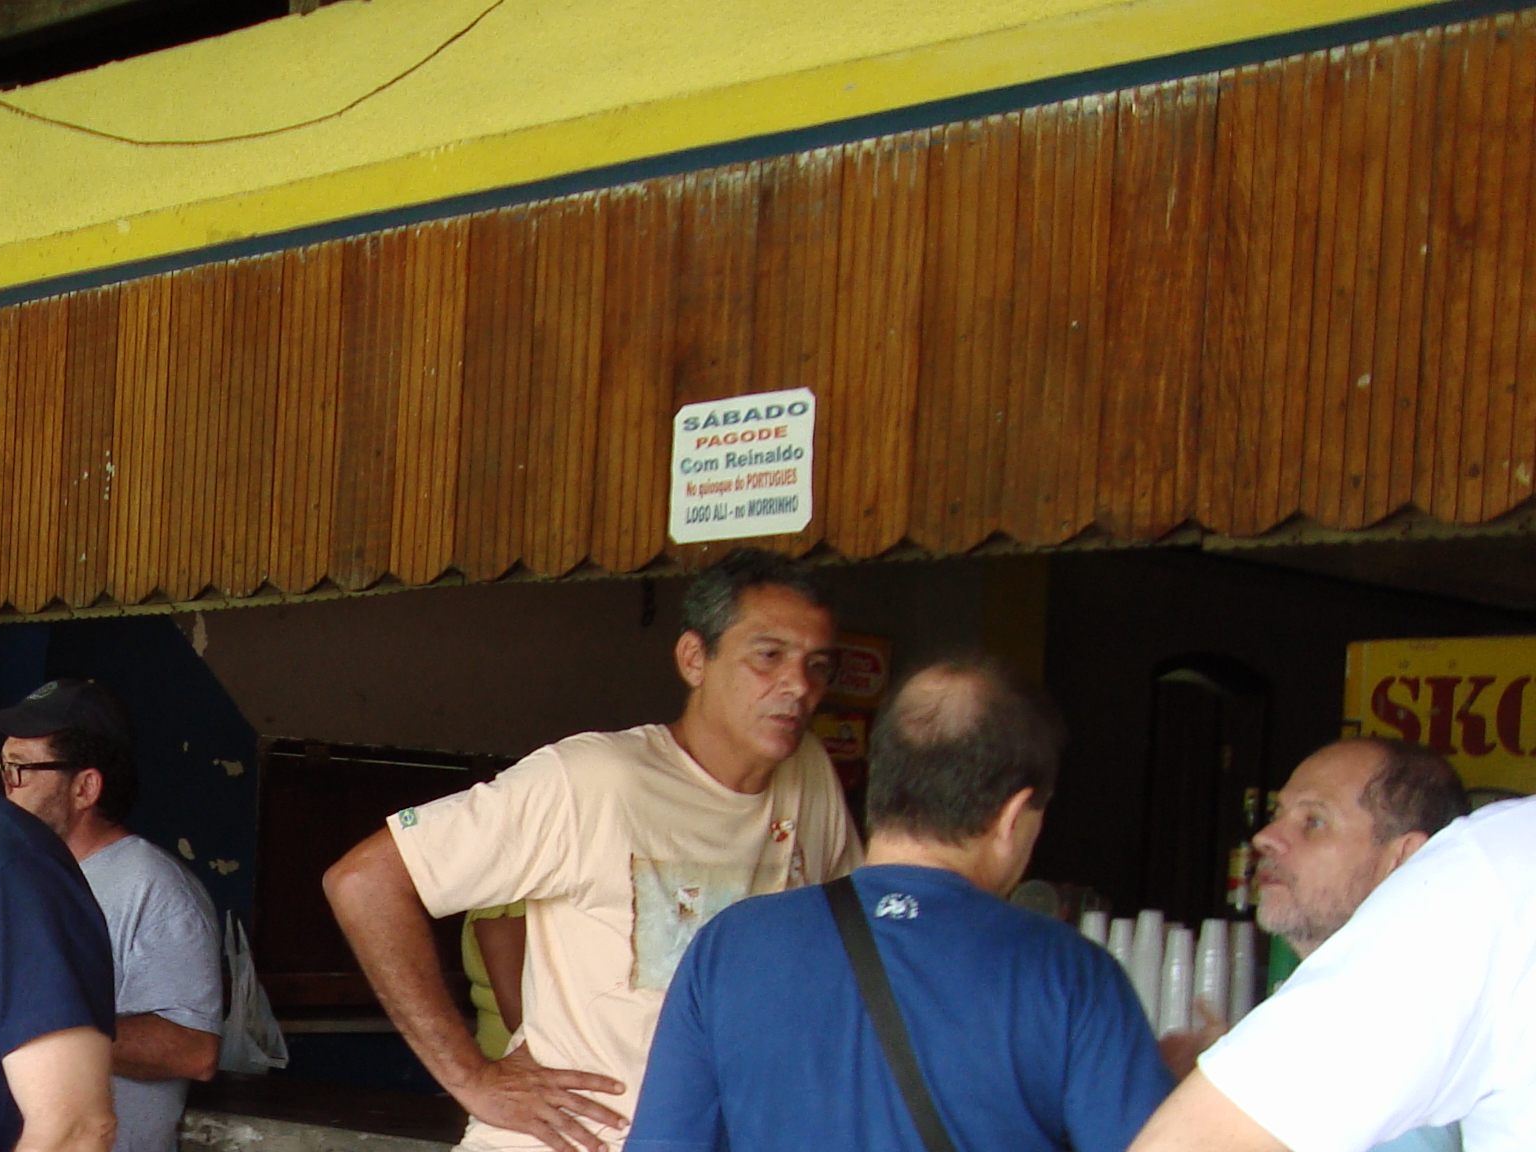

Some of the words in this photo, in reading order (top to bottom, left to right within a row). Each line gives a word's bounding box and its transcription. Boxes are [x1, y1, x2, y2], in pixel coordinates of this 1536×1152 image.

[695, 425, 789, 449] PAGODE
[680, 457, 719, 475] Com
[725, 444, 805, 469] Reinaldo
[734, 473, 745, 489] do
[685, 503, 712, 525] LOGO
[713, 501, 728, 521] ALI
[735, 504, 746, 520] no
